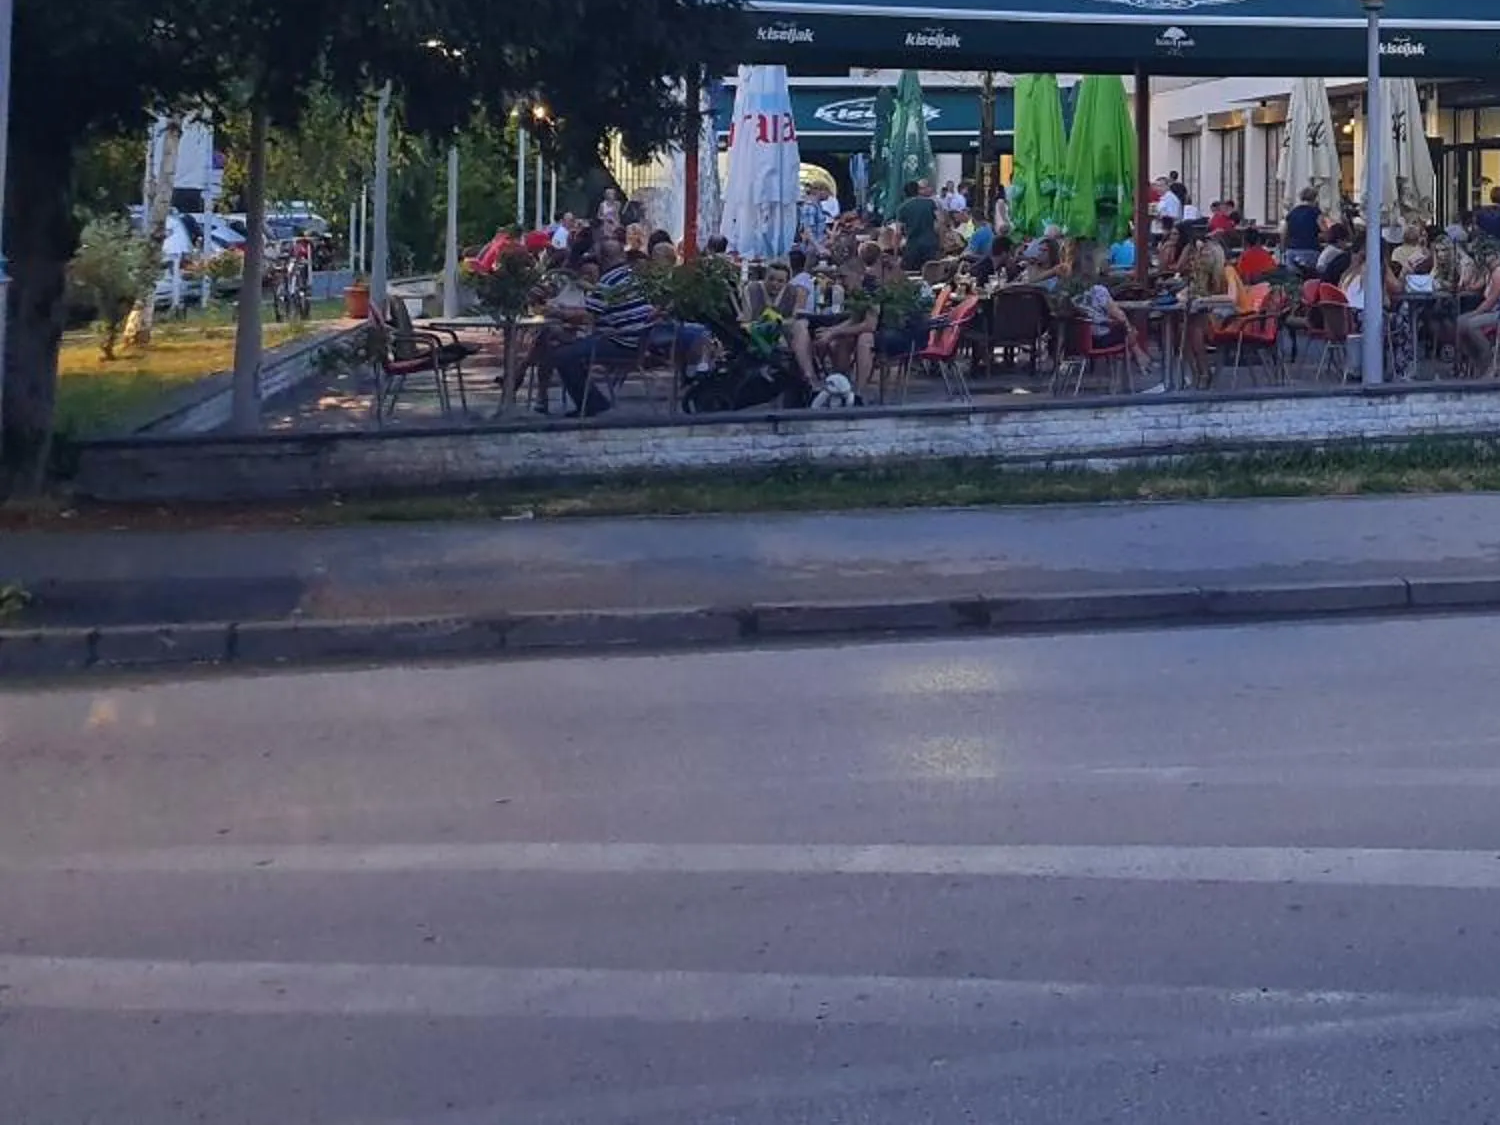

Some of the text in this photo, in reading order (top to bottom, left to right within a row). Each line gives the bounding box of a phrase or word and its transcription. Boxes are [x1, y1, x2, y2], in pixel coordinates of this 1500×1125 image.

[757, 27, 814, 44] kiseljak
[905, 32, 961, 49] kiseljak
[1378, 42, 1425, 57] kiseljak
